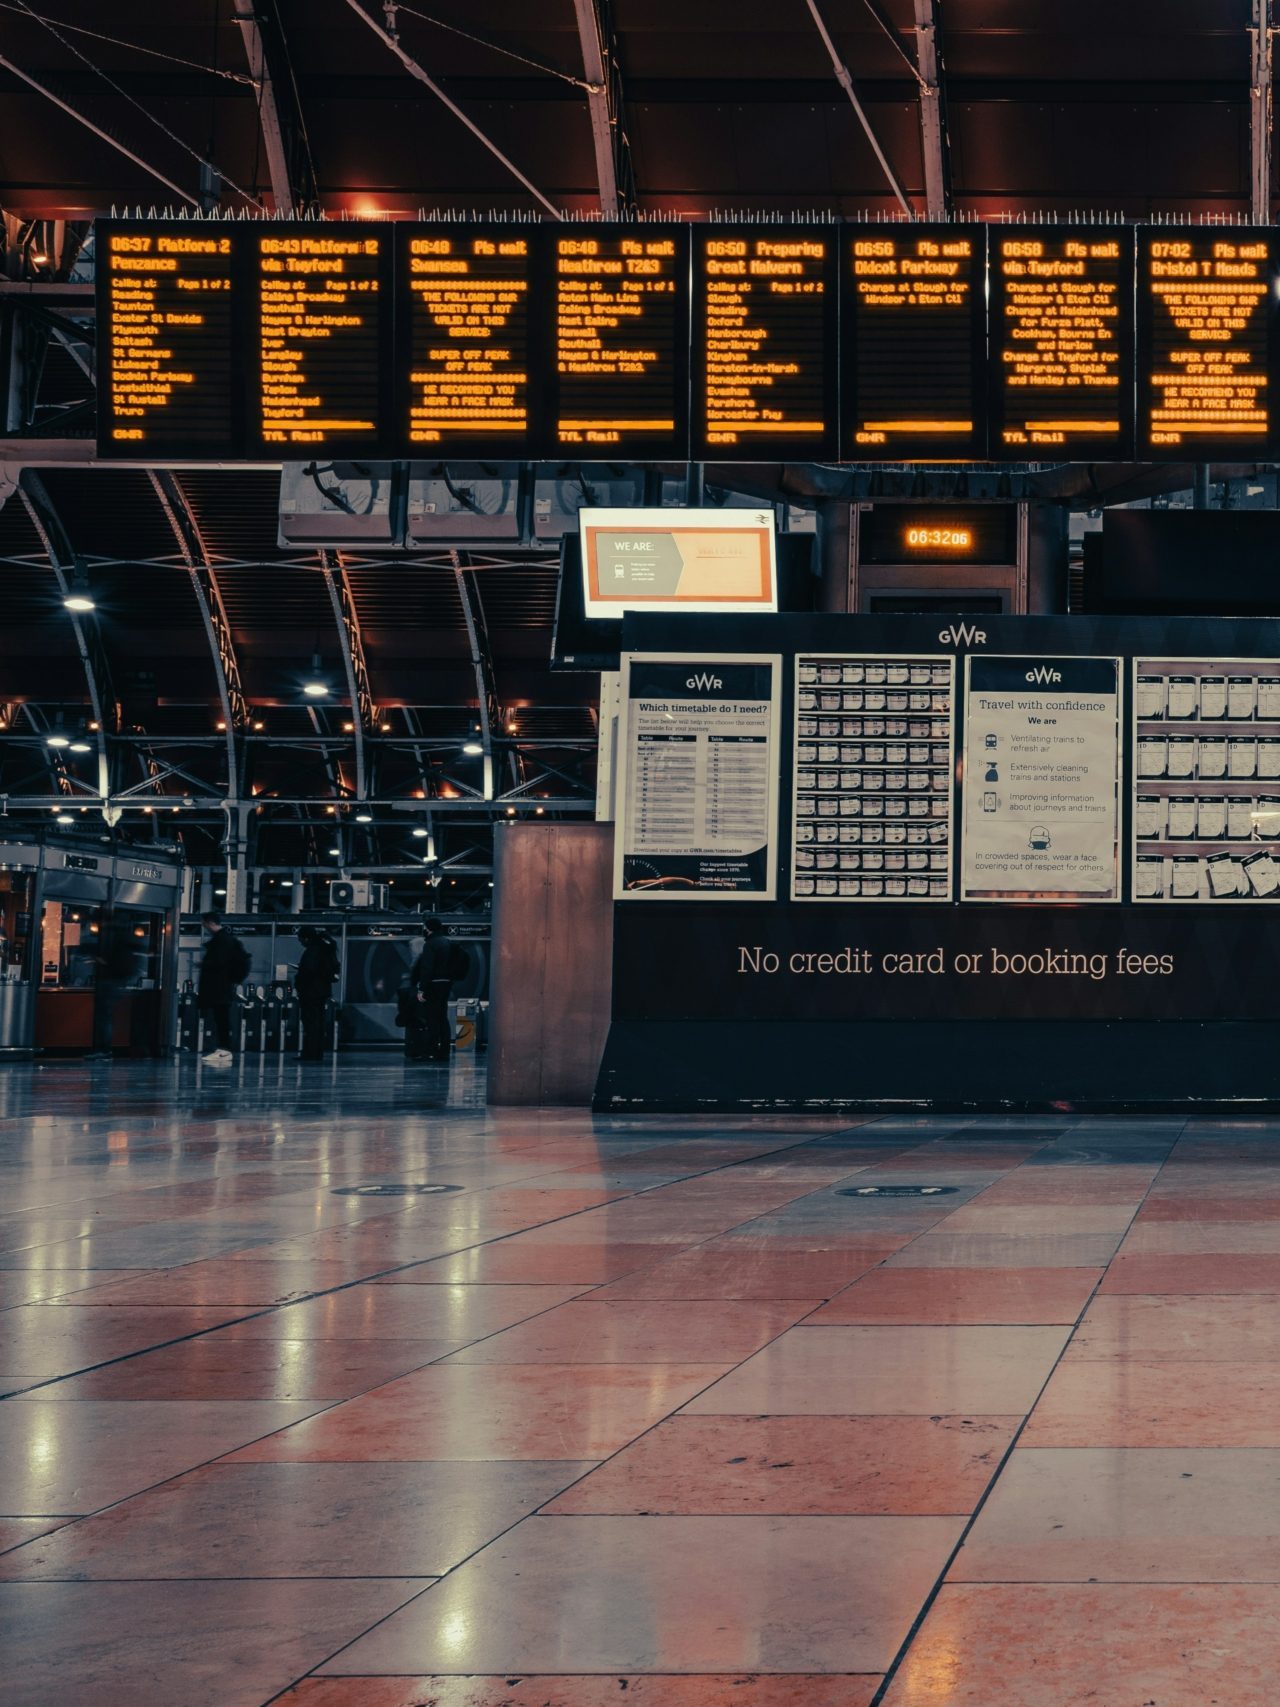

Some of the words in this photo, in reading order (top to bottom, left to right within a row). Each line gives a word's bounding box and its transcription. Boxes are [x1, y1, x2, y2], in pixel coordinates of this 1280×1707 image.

[110, 236, 152, 252] 06:37
[218, 238, 231, 254] 2
[260, 238, 301, 254] 06:43
[361, 239, 379, 255] 12
[410, 239, 451, 255] 06:48
[473, 240, 496, 255] Pls
[498, 240, 528, 256] wait
[558, 240, 599, 256] 06:48
[621, 240, 643, 256] Pls
[645, 240, 675, 256] wait
[706, 241, 747, 257] 06:50
[756, 241, 824, 258] Preparing
[854, 241, 895, 257] 06:56
[917, 241, 940, 257] Pls
[941, 241, 971, 257] wait
[1002, 241, 1043, 258] 06:58
[1065, 242, 1088, 258] Pls
[1089, 242, 1120, 258] wait
[1151, 242, 1192, 259] 07:02
[1213, 242, 1237, 259] Pls
[1238, 243, 1268, 259] wait
[110, 255, 177, 271] Penzance
[410, 257, 469, 274] Swansea
[557, 258, 623, 274] Heathrow
[625, 258, 661, 274] T2&3
[706, 259, 747, 275] Great
[749, 259, 803, 275] Malvern
[854, 260, 898, 275] Didcot
[900, 259, 959, 276] Parkway
[1151, 260, 1199, 277] Bristol
[1200, 261, 1212, 276] T
[614, 542, 631, 551] WE
[633, 542, 654, 551] ARE:
[938, 622, 986, 647] GWR
[686, 672, 722, 692] GWR
[1025, 665, 1062, 685] GWR
[639, 703, 669, 712] Which
[671, 703, 716, 713] timetable
[719, 704, 731, 713] do
[733, 705, 738, 713] I
[739, 705, 767, 714] need?
[979, 700, 1014, 710] Travel
[1017, 700, 1042, 710] with
[1045, 701, 1106, 711] confidence
[1028, 717, 1041, 725] We
[1010, 734, 1052, 745] Ventilating
[1052, 735, 1075, 744] trains
[1076, 736, 1084, 744] to
[1010, 743, 1039, 752] refresh
[1040, 744, 1050, 752] air
[1009, 762, 1054, 773] Extensively
[1055, 763, 1088, 773] cleaning
[1009, 772, 1032, 781] trains
[1033, 773, 1048, 781] and
[1049, 773, 1081, 782] stations
[1009, 793, 1048, 803] Improving
[1049, 793, 1095, 802] information
[1008, 803, 1031, 812] about
[1032, 804, 1067, 814] journeys
[1068, 804, 1083, 812] and
[1084, 804, 1106, 812] trains
[975, 852, 983, 860] In
[984, 852, 1019, 861] crowded
[1019, 853, 1050, 863] spaces,
[1051, 853, 1072, 861] wear
[1080, 853, 1097, 862] face
[974, 861, 1008, 872] covering
[1009, 862, 1023, 870] out
[1024, 862, 1033, 870] of
[1033, 862, 1064, 872] respect
[1065, 863, 1077, 871] for
[1078, 863, 1103, 871] others
[738, 946, 780, 973] No
[789, 947, 872, 974] credit
[882, 948, 945, 974] card
[954, 955, 983, 974] or
[991, 948, 1108, 979] booking
[1116, 949, 1174, 975] fees
